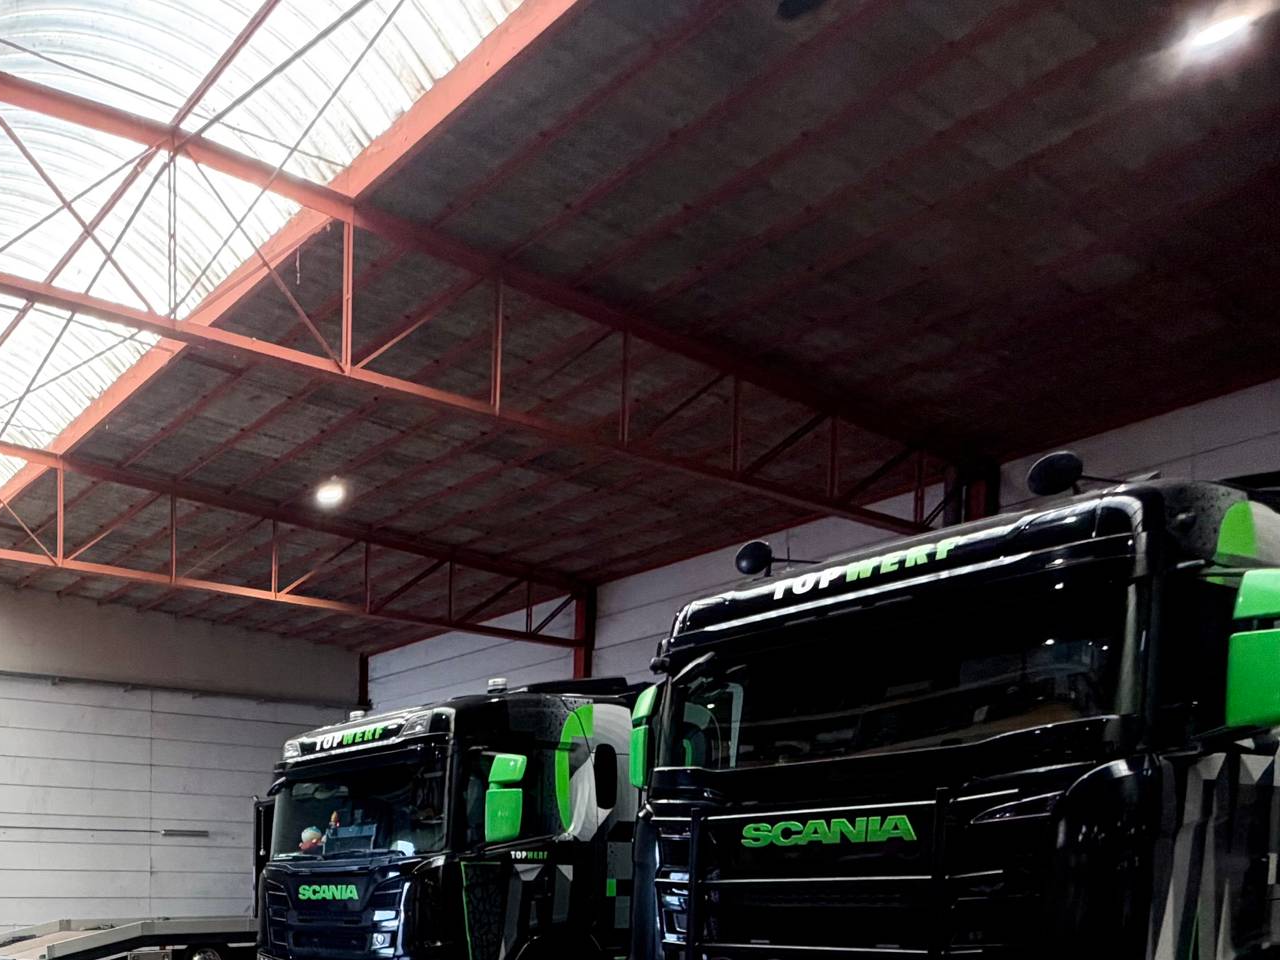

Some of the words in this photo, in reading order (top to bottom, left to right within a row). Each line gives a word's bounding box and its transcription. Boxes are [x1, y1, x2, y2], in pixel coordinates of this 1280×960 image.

[773, 536, 962, 600] TOPWERF
[315, 725, 385, 751] TOPWERF
[741, 815, 918, 848] SCANIA
[298, 884, 359, 900] SCANIA
